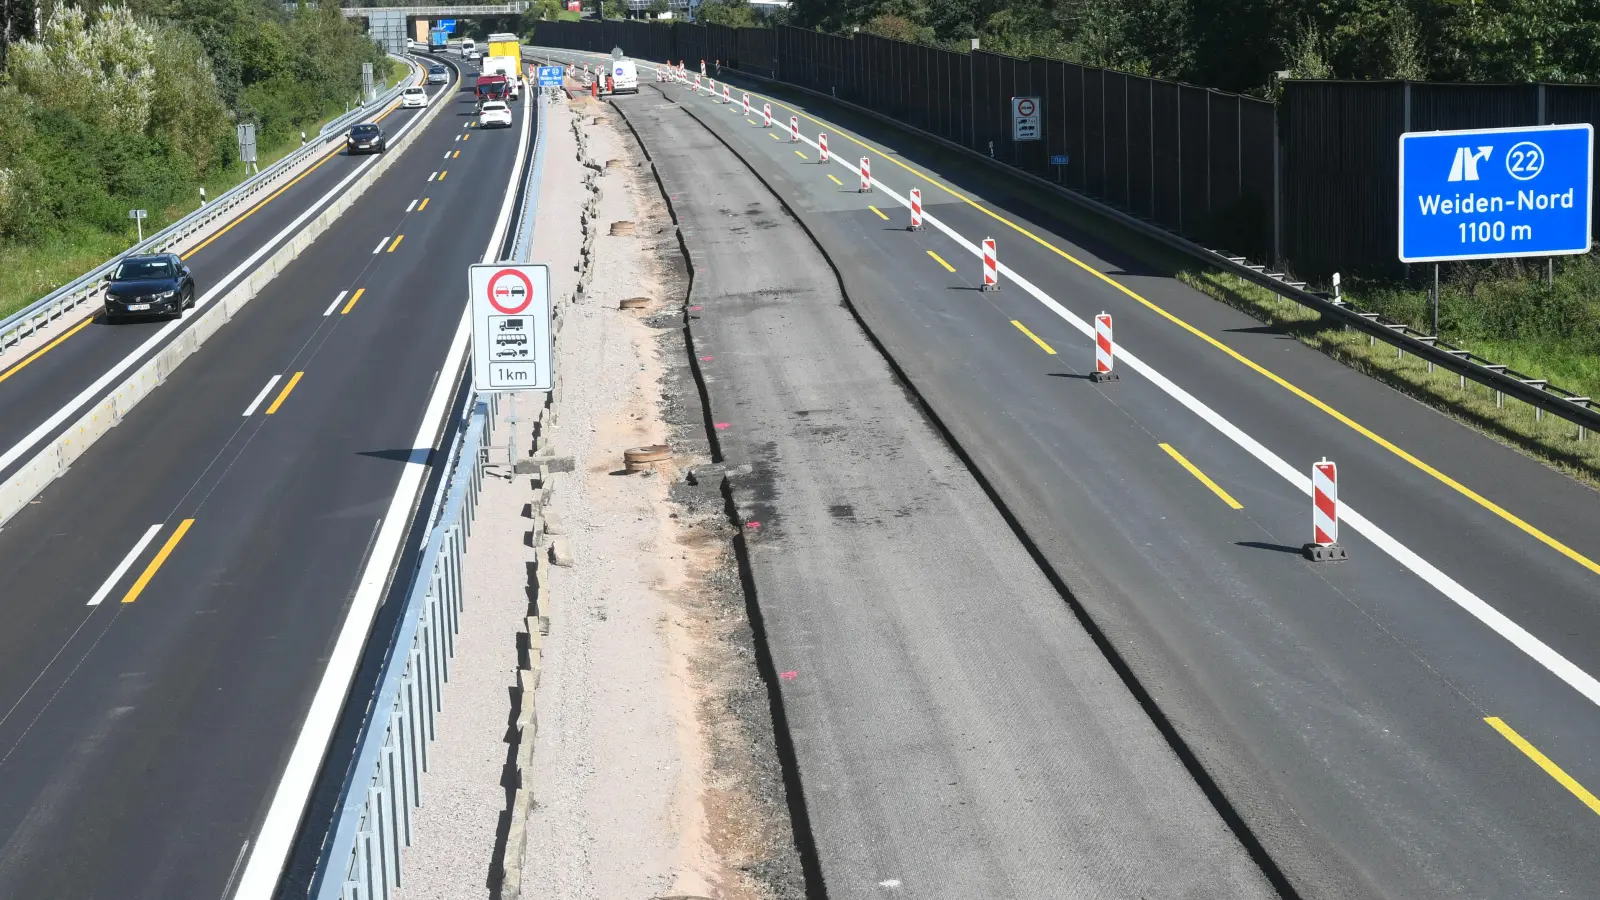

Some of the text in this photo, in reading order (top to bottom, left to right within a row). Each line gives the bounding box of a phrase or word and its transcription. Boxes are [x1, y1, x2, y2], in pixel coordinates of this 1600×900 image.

[1511, 150, 1539, 172] 22
[1418, 187, 1574, 216] Weiden-Nord
[1458, 220, 1532, 243] 1100 m
